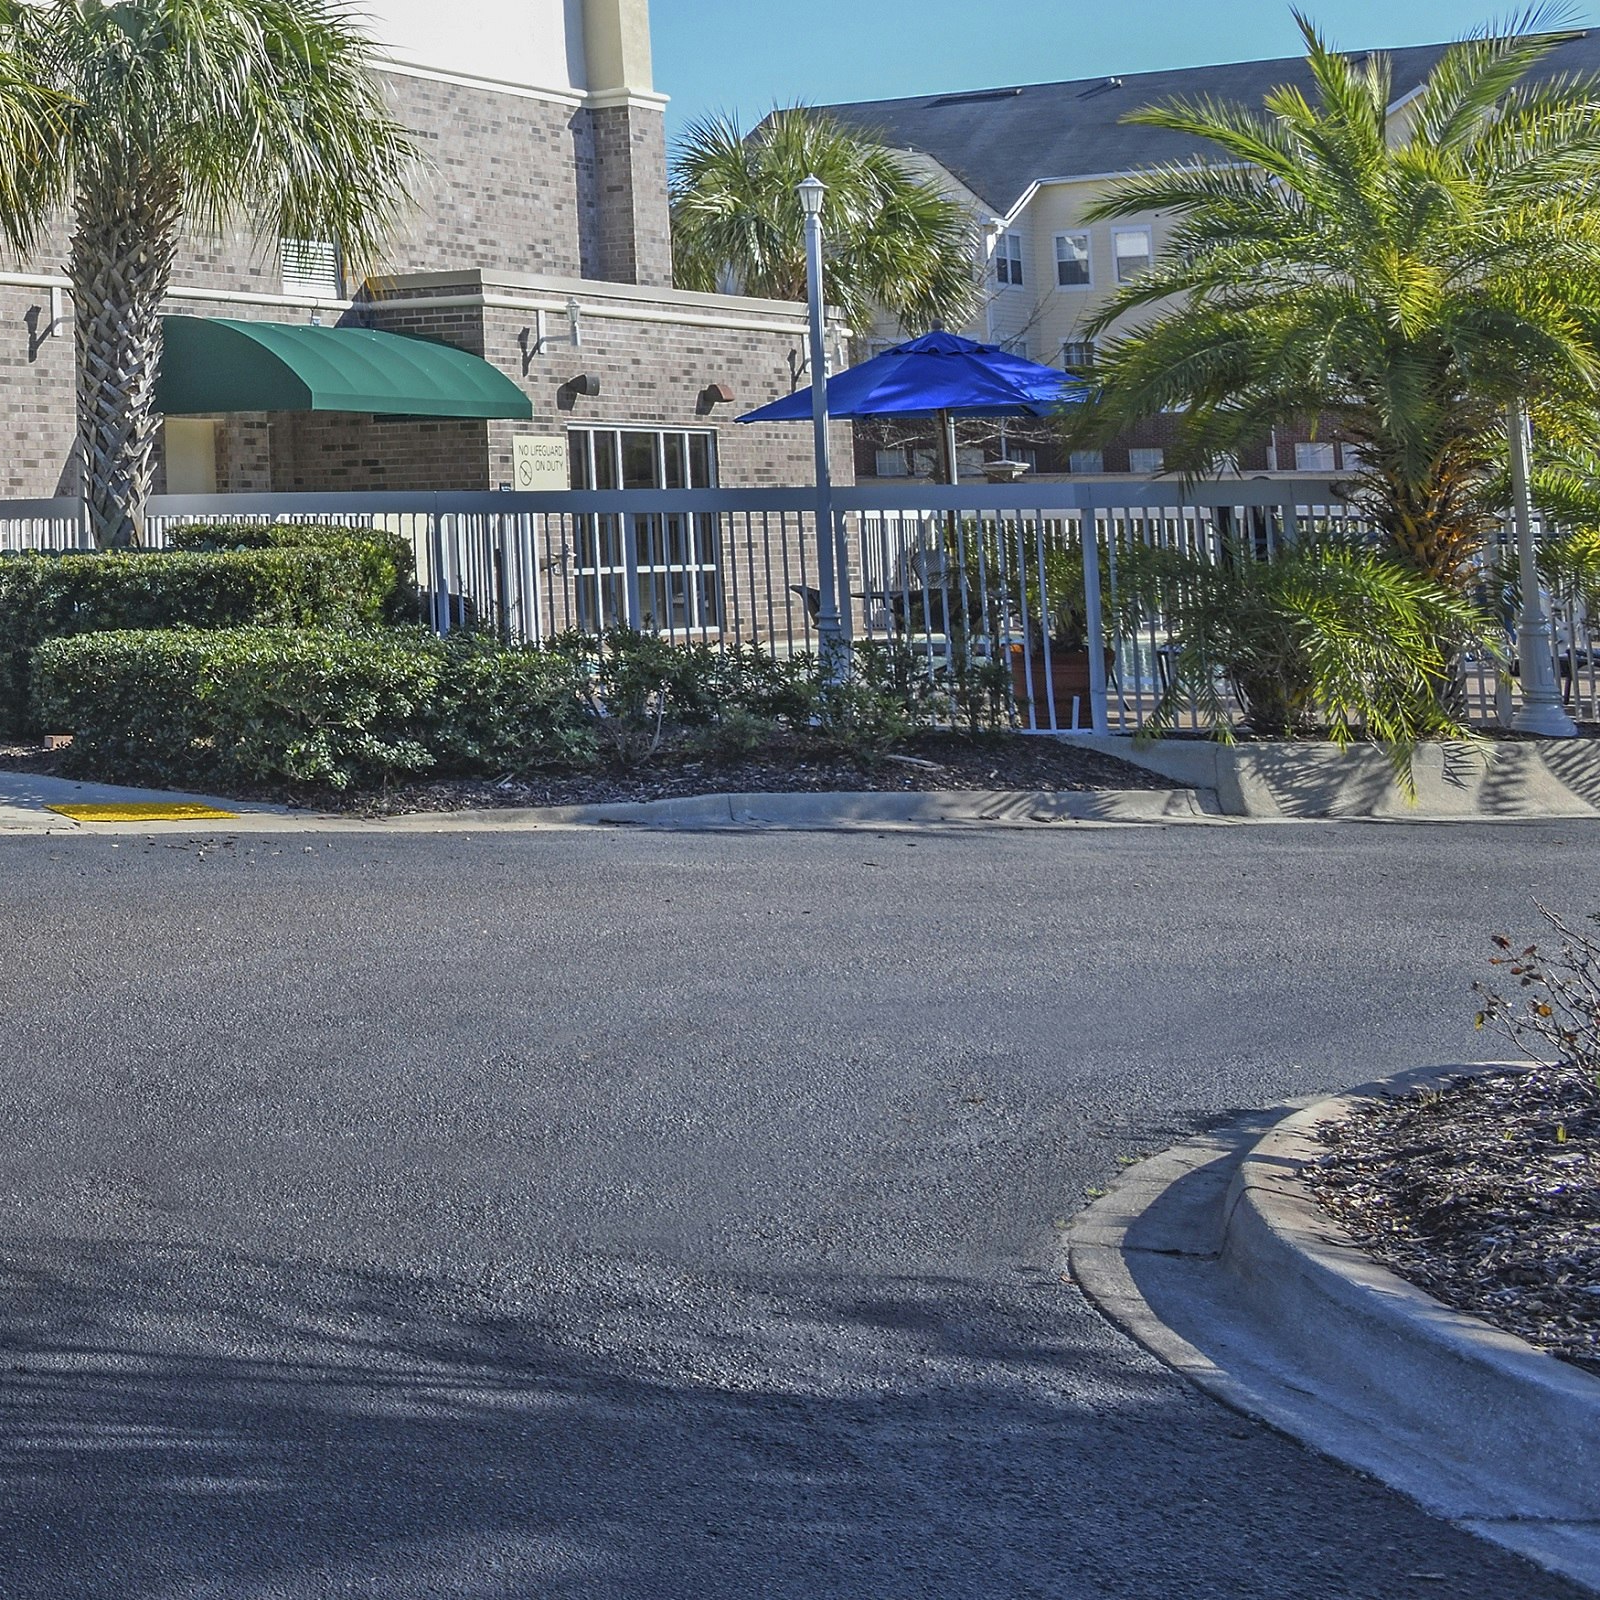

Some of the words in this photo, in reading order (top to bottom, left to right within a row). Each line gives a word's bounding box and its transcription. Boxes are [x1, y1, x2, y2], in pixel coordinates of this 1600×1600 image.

[518, 445, 529, 456] NO
[531, 445, 563, 457] LIFEGUARD
[535, 460, 545, 471] ON
[547, 461, 564, 471] DUTY
